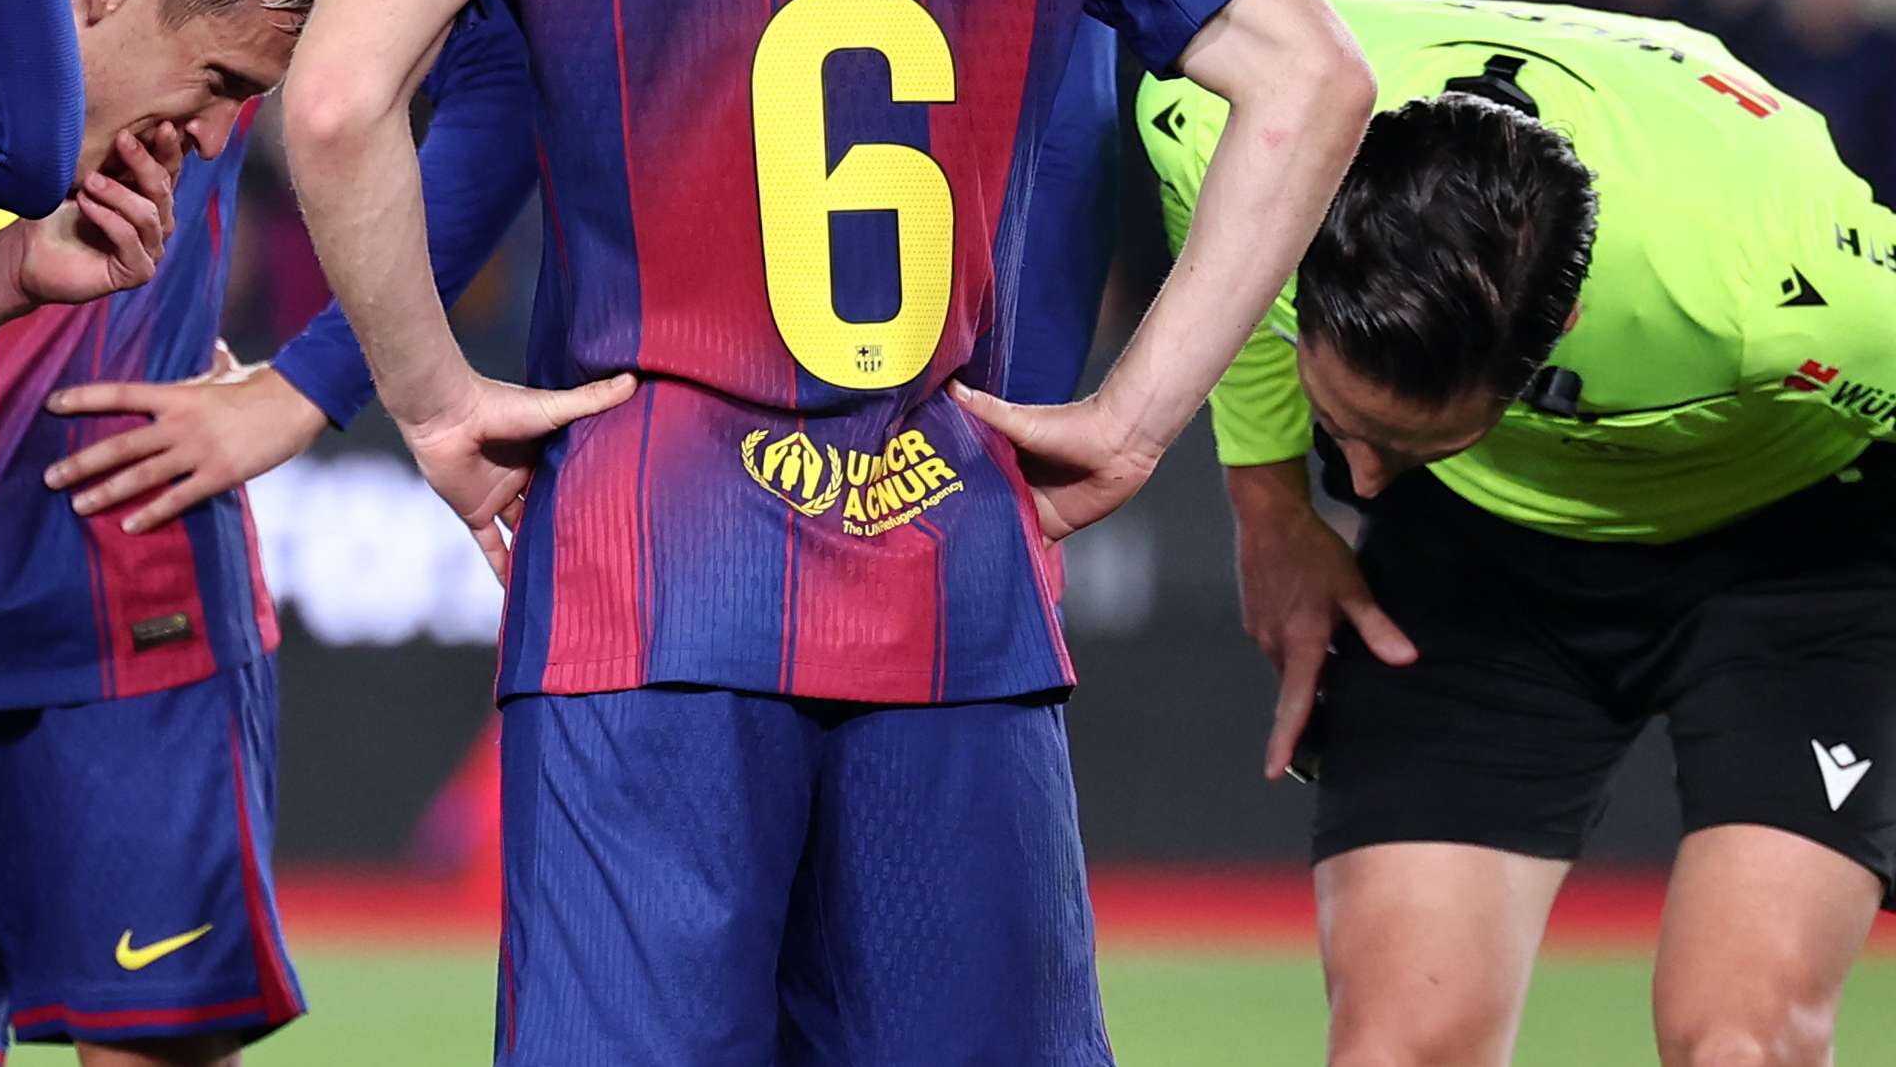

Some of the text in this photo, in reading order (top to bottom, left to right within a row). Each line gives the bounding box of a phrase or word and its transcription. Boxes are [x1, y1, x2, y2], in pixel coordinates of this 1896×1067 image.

[843, 457, 957, 522] ACNUR
[843, 520, 863, 536] The
[921, 480, 964, 511] Agency
